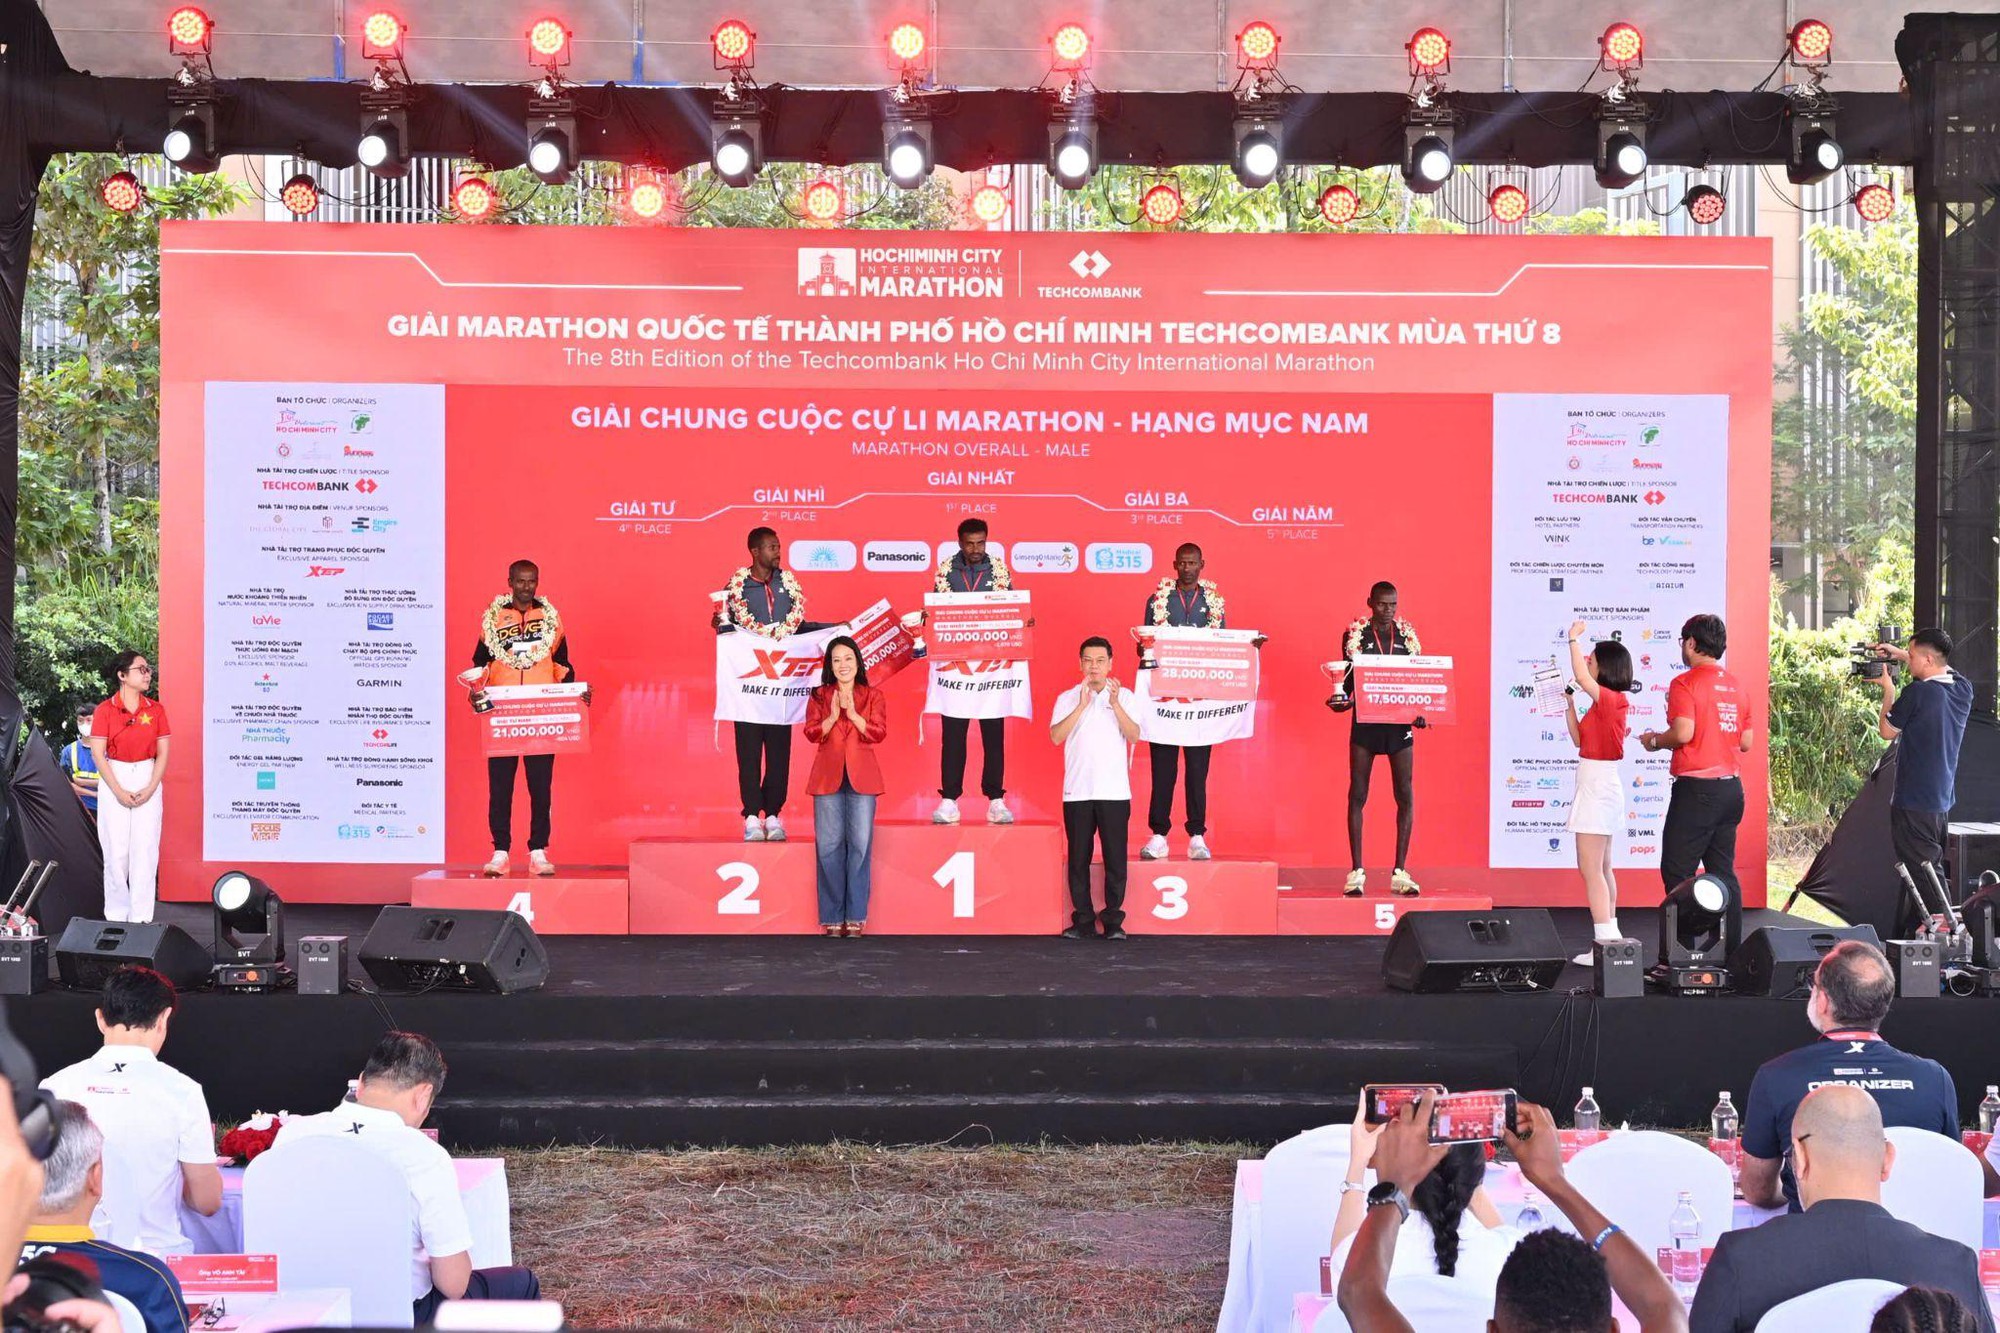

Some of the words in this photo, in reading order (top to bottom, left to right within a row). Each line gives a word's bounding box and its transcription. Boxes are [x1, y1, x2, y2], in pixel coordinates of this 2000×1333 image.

[860, 249, 957, 263] HOCHIMINH
[962, 249, 1002, 263] CITY
[860, 266, 1003, 275] INTERNATIONAL
[861, 278, 1003, 298] MARATHON
[1038, 287, 1142, 299] TECHCOMBANK
[388, 312, 448, 337] GIẢI
[458, 317, 629, 338] MARATHON
[638, 314, 726, 341] QUỐC
[734, 314, 772, 340] TẾ
[777, 316, 881, 342] THÀNH
[890, 316, 955, 343] PHỐ
[962, 318, 1006, 343] HỒ
[1014, 316, 1068, 344] CHÍ
[1074, 322, 1152, 344] MINH
[1161, 322, 1390, 344] TECHCOMBANK
[1399, 318, 1466, 344] MÙA
[1474, 318, 1537, 344] THỨ
[1542, 323, 1561, 344] 8
[563, 348, 602, 366] The
[610, 348, 644, 367] 8th
[652, 348, 723, 368] Edition
[732, 349, 752, 368] of
[758, 350, 791, 368] the
[800, 350, 946, 370] Techcombank
[955, 352, 984, 370] Ho
[991, 352, 1026, 371] Chi
[1033, 352, 1083, 371] Minh
[1091, 352, 1132, 375] City
[1138, 353, 1268, 371] International
[1276, 354, 1374, 372] Marathon
[306, 396, 327, 404] CHỨC
[572, 402, 630, 428] GIẢI
[640, 408, 748, 430] CHUNG
[758, 403, 843, 436] CUỘC
[852, 406, 896, 436] CỰ
[904, 410, 926, 431] LI
[937, 410, 1104, 432] MARATHON
[1132, 412, 1215, 438] HẠNG
[1226, 412, 1292, 438] MỤC
[1302, 412, 1368, 434] NAM
[852, 442, 948, 456] MARATHON
[954, 442, 1029, 456] OVERALL
[1046, 444, 1090, 456] MALE
[928, 470, 962, 485] GIẢI
[968, 468, 1015, 485] NHẤT
[262, 481, 349, 491] TECHCOMBANK
[754, 488, 788, 502] GIẢI
[794, 486, 825, 502] NHÌ
[1125, 490, 1159, 506] GIẢI
[1165, 492, 1189, 505] BA
[1553, 494, 1638, 503] TECHCOMBANK
[610, 500, 645, 516] GIẢI
[651, 500, 676, 515] TƯ
[962, 504, 997, 513] PLACE
[1252, 505, 1287, 520] GIẢI
[1292, 505, 1332, 520] NĂM
[781, 512, 816, 521] PLACE
[1147, 515, 1182, 524] PLACE
[373, 525, 386, 533] City
[635, 524, 671, 534] PLACE
[1283, 530, 1318, 539] PLACE
[1545, 534, 1570, 543] WINK
[1642, 536, 1654, 546] be
[868, 552, 925, 562] Panasonic
[1116, 556, 1141, 568] 315
[252, 615, 281, 625] laVie
[937, 631, 1008, 643] 70,000,000
[1162, 668, 1234, 679] 28,000,000
[357, 679, 401, 687] GARMIN
[938, 677, 962, 690] MAKE
[966, 682, 975, 691] IT
[978, 679, 1023, 691] DIFFERENT
[742, 684, 767, 695] MAKE
[770, 687, 781, 696] IT
[783, 687, 813, 697] DIFFER
[1367, 694, 1432, 705] 17,500,000
[1157, 708, 1182, 720] MAKE
[1185, 711, 1194, 720] IT
[1198, 703, 1249, 719] DIFFERENT
[492, 725, 564, 738] 21,000,000
[1542, 731, 1554, 741] ila
[242, 734, 290, 744] Pharmacity
[357, 779, 403, 787] Panasonic
[352, 829, 370, 838] 315
[1630, 845, 1655, 854] pops
[716, 862, 760, 914] 2
[932, 852, 975, 917] 1
[1152, 876, 1188, 920] 3
[506, 892, 534, 925] 4
[1375, 904, 1395, 929] 5
